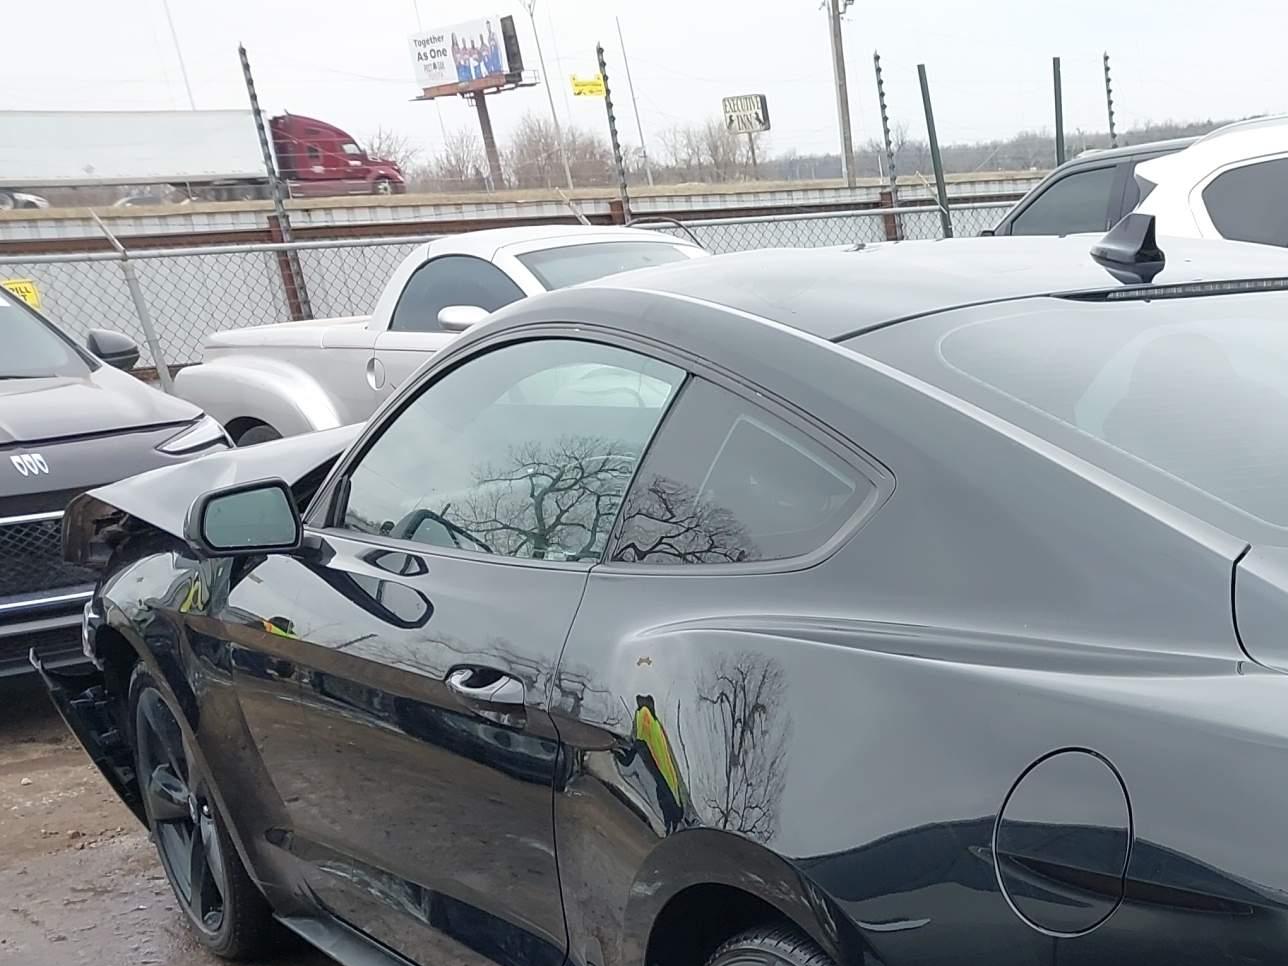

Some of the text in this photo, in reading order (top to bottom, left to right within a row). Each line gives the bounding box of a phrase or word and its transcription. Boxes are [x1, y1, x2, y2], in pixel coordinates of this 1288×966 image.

[413, 35, 444, 48] Together
[417, 48, 448, 62] As One
[724, 96, 761, 113] EXECUTIVE
[736, 113, 754, 131] INN
